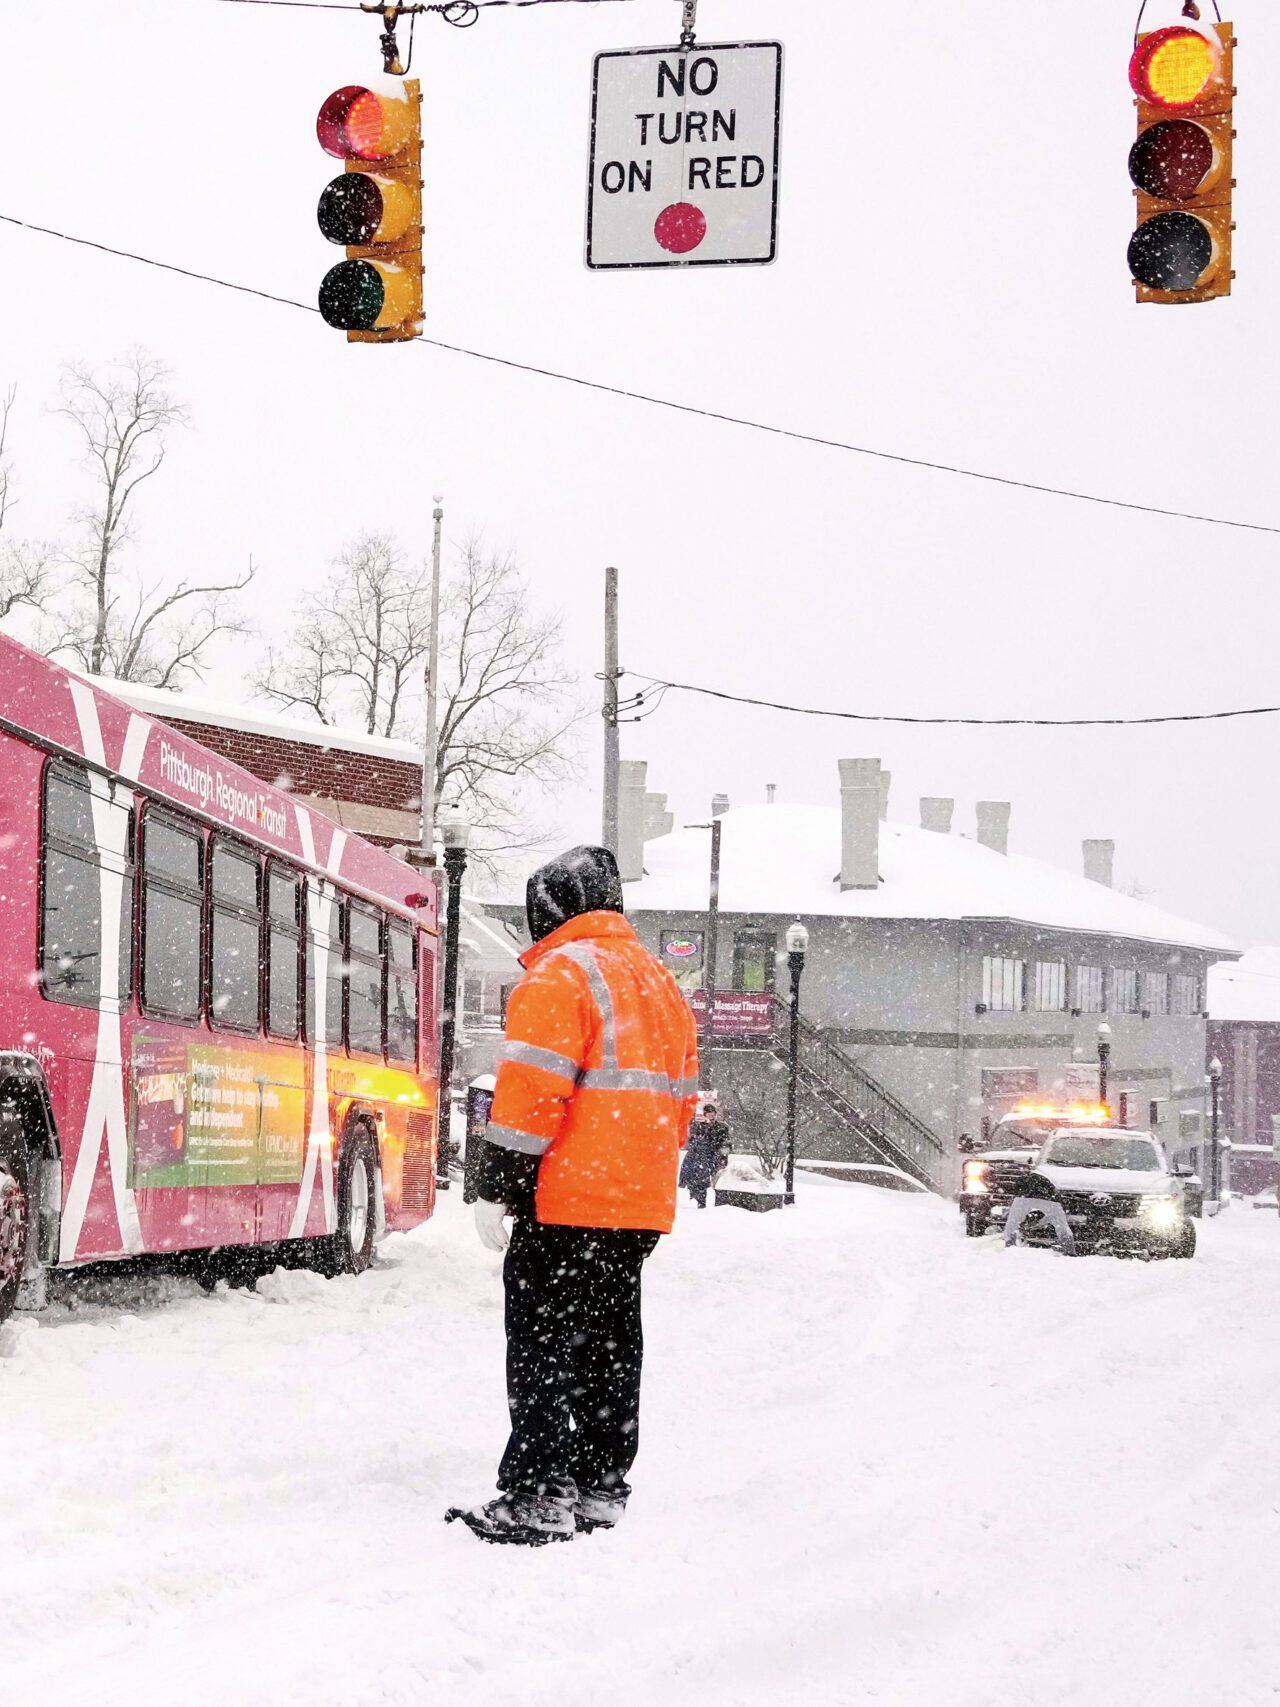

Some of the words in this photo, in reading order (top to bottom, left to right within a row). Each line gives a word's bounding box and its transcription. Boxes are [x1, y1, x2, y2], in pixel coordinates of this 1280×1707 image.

[657, 57, 718, 97] NO
[634, 109, 736, 145] TURN
[601, 160, 652, 193] ON
[689, 155, 765, 190] RED
[160, 741, 213, 807] Pittsburgh
[216, 771, 257, 822] Regional
[259, 795, 286, 838] Transit
[715, 999, 742, 1013] Massage
[742, 1000, 768, 1014] Therapy
